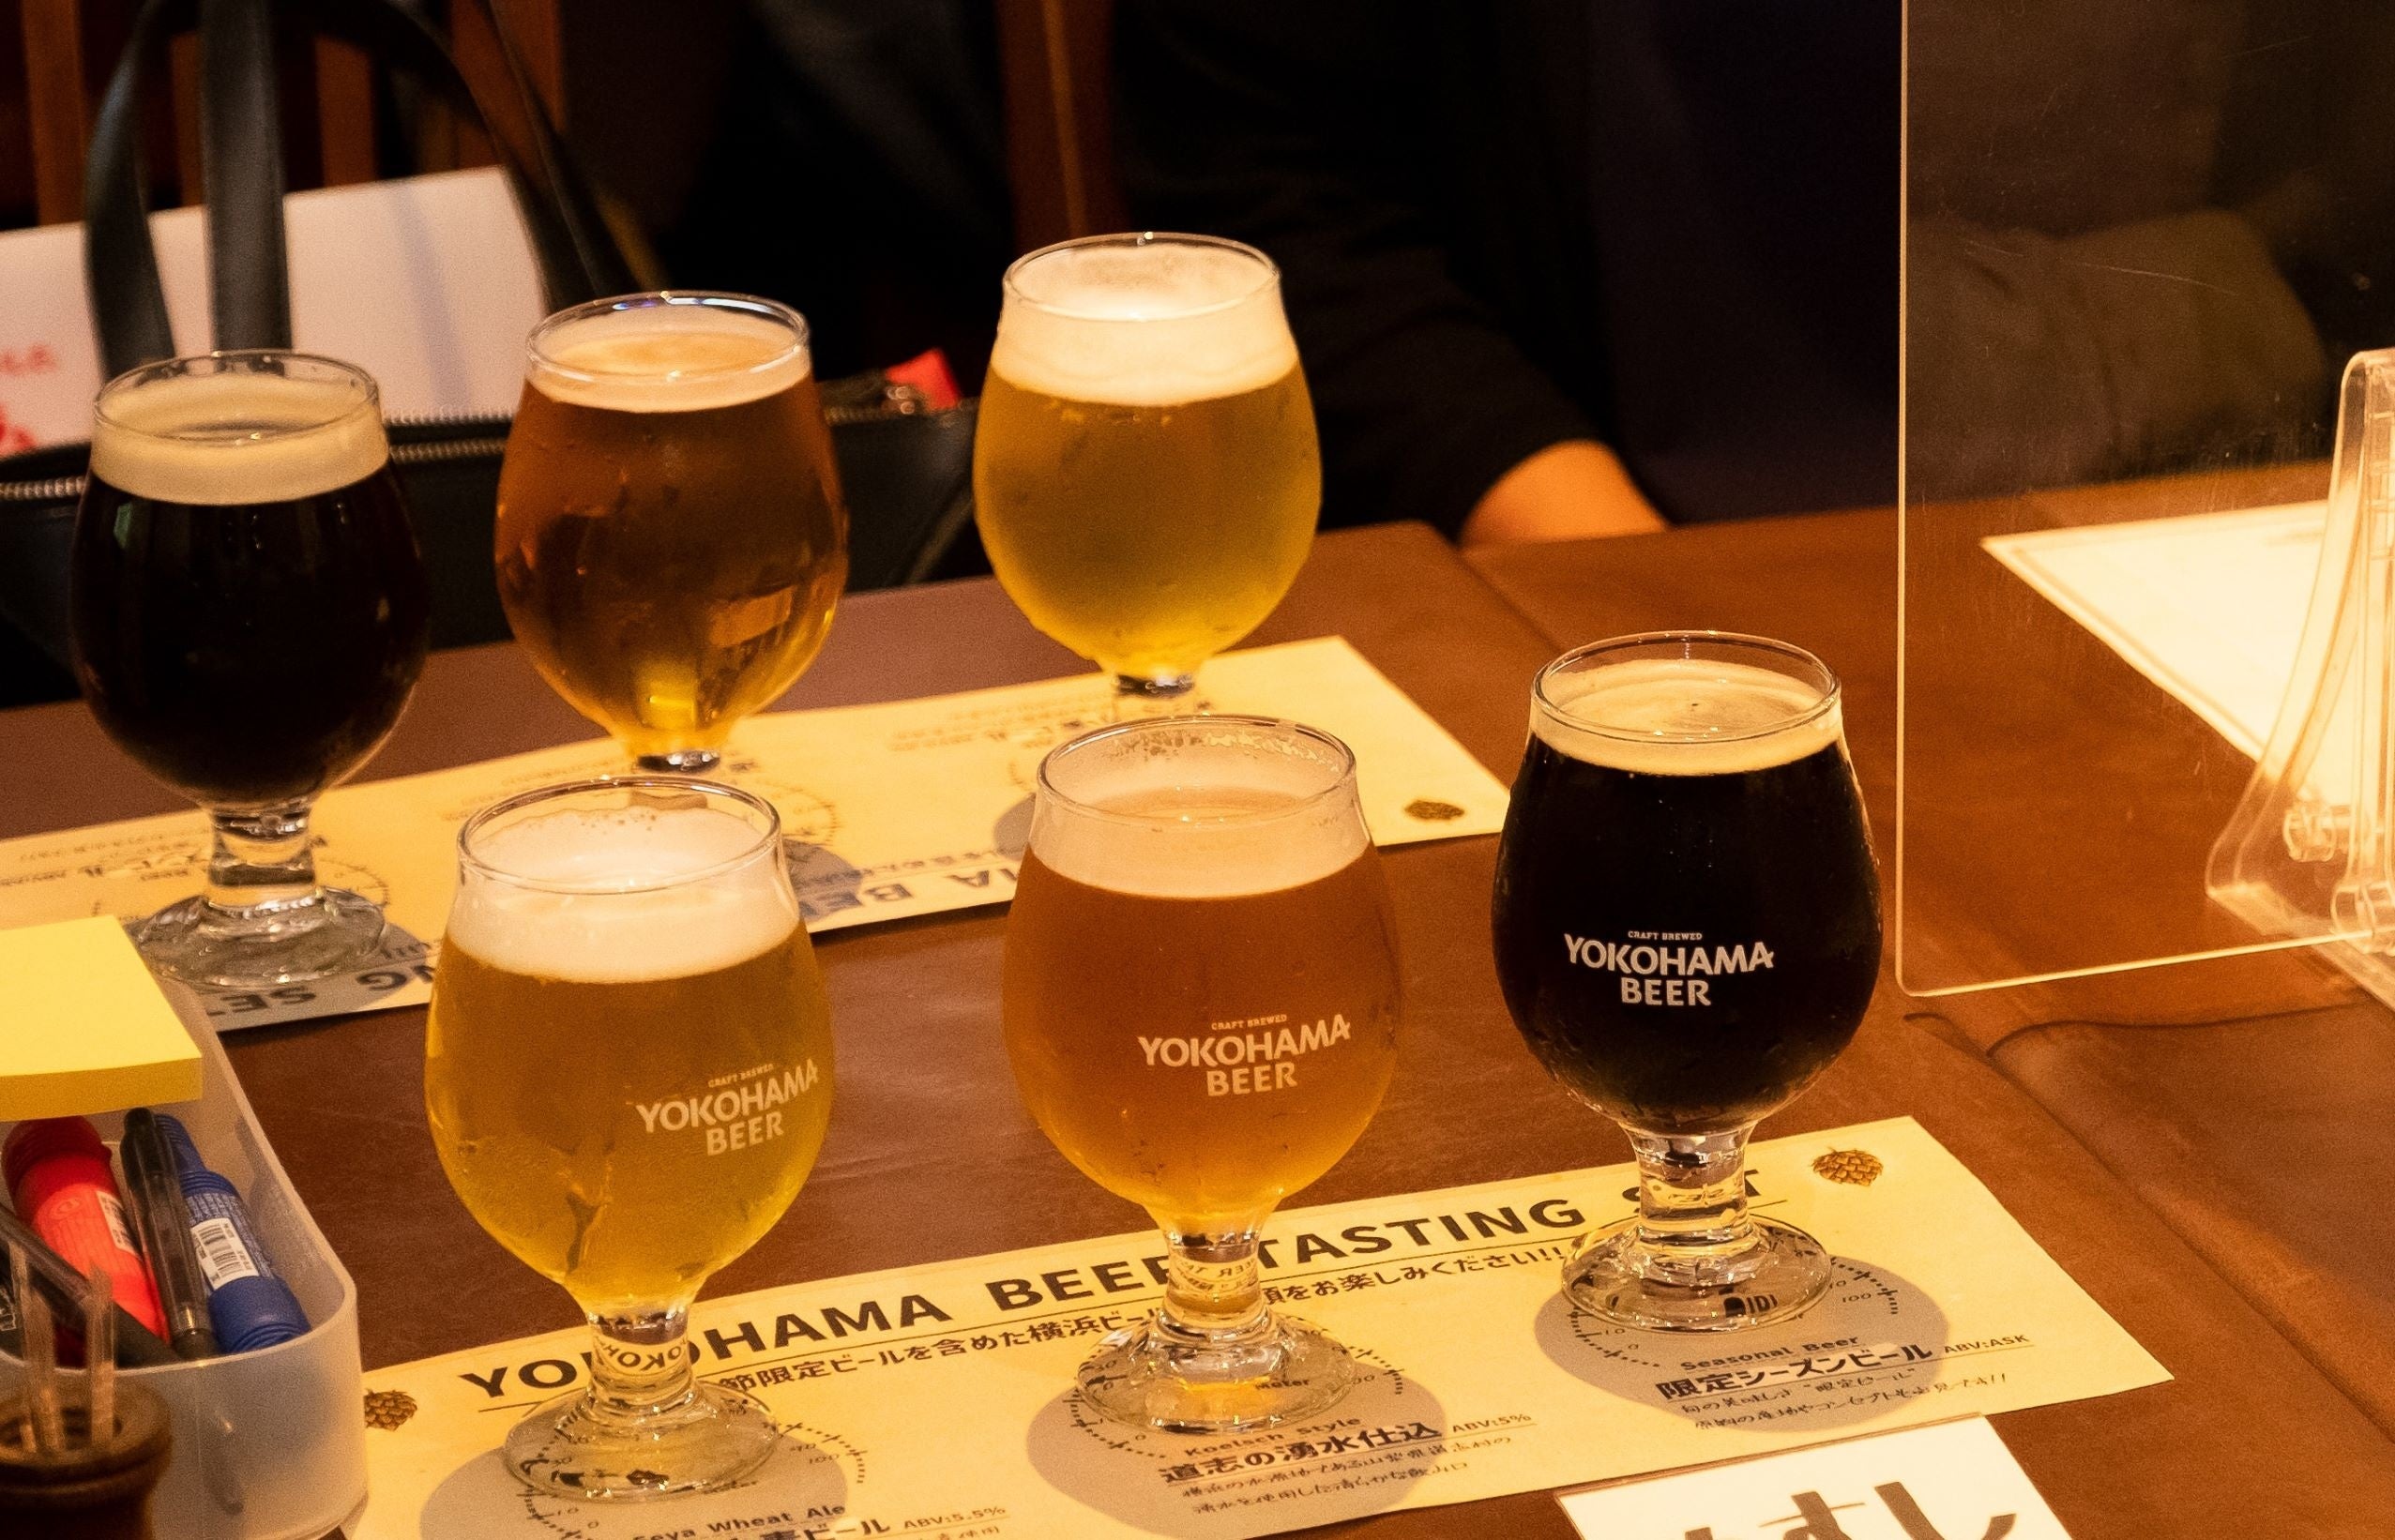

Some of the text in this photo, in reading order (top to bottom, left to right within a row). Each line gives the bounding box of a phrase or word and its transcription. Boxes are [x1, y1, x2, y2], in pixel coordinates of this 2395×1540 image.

[1564, 933, 1775, 976] YOKOHAMA
[1628, 930, 1703, 942] CRAFT BREWED
[1621, 976, 1712, 1006] BEER
[1137, 1013, 1351, 1067] YOKOHAMA
[1211, 1014, 1288, 1031] CRAFT BREWED
[635, 1058, 819, 1133] YOKOHAMA
[1206, 1061, 1298, 1097] BEER
[705, 1110, 784, 1156] BEER
[458, 1294, 953, 1398] YOHAMA
[1680, 1336, 1858, 1371] Seasonal Beer
[1656, 1334, 2030, 1400] 限定シーズンビール ABV:ASK
[1159, 1412, 1533, 1484] 道志の湧水仕込 ABV:5%
[1184, 1417, 1361, 1457] Koelsch Style
[707, 1513, 794, 1532] Wheat
[808, 1504, 846, 1519] Ale
[903, 1506, 1006, 1530] ABV:5.5%
